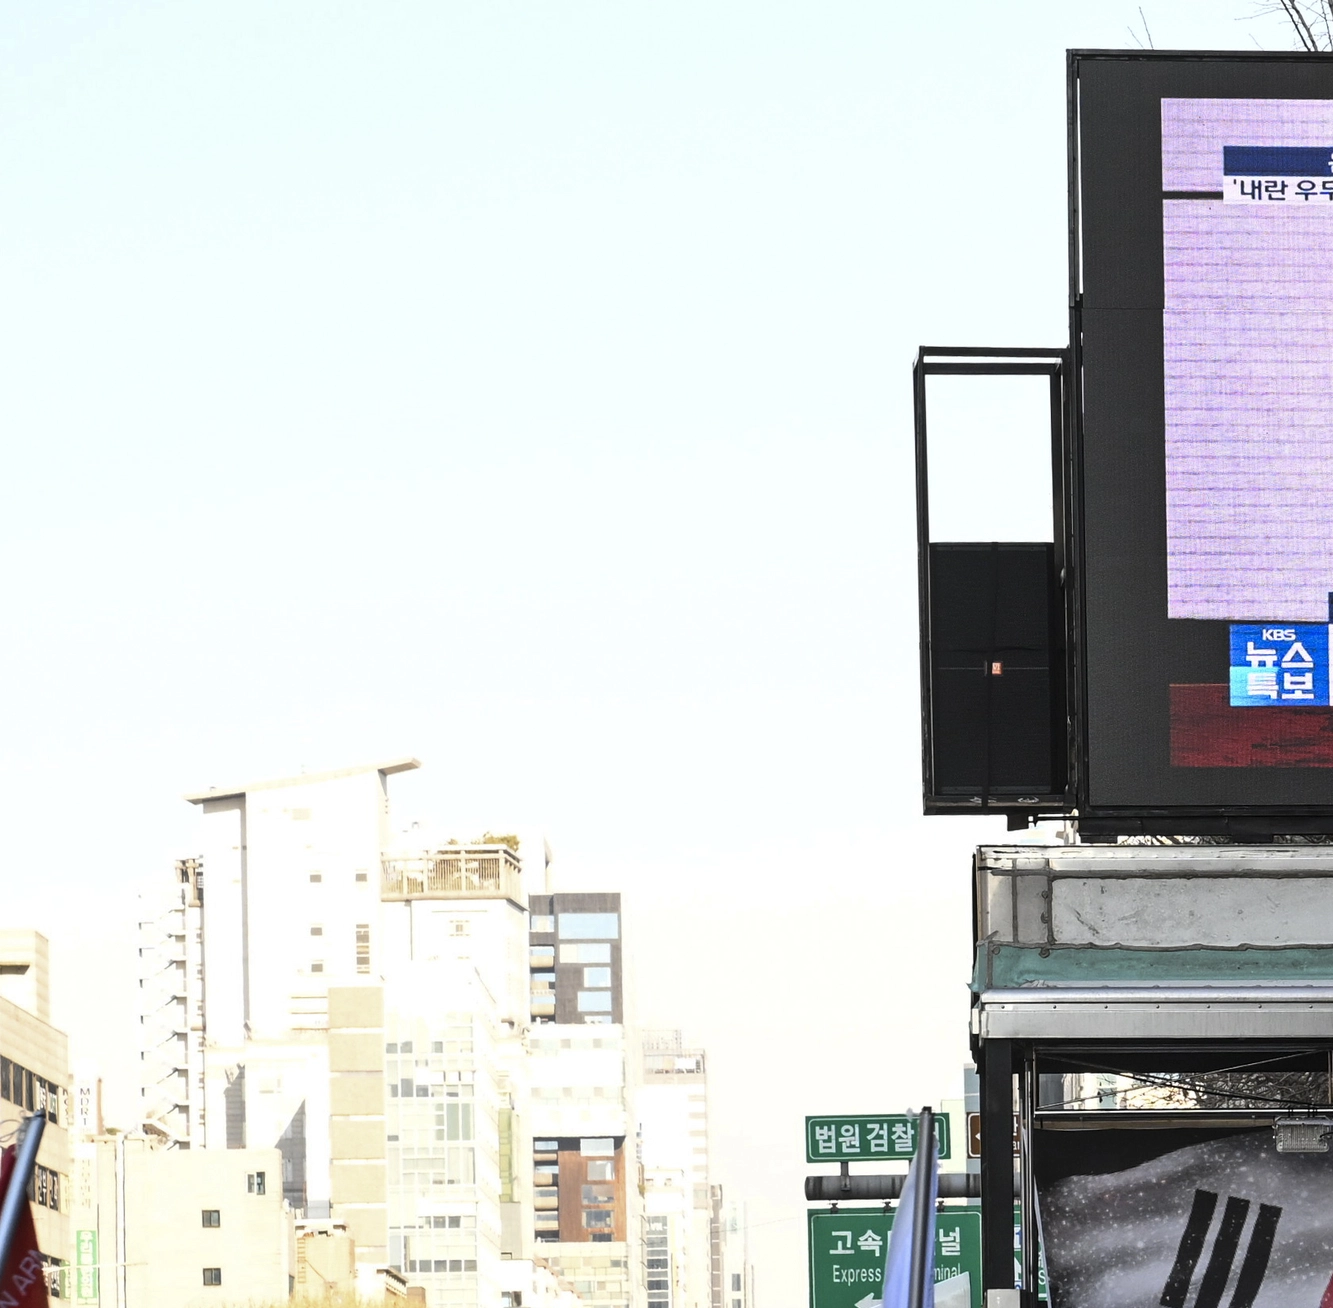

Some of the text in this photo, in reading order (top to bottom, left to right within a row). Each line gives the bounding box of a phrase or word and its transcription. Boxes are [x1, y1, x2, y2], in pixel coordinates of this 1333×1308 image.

[1233, 179, 1288, 201] '내란
[1262, 628, 1297, 642] KBS
[1245, 642, 1314, 669] 뉴스
[1245, 671, 1315, 701] 특보
[815, 1124, 861, 1154] 법원
[829, 1227, 961, 1257] 고속널
[832, 1265, 882, 1286] Express
